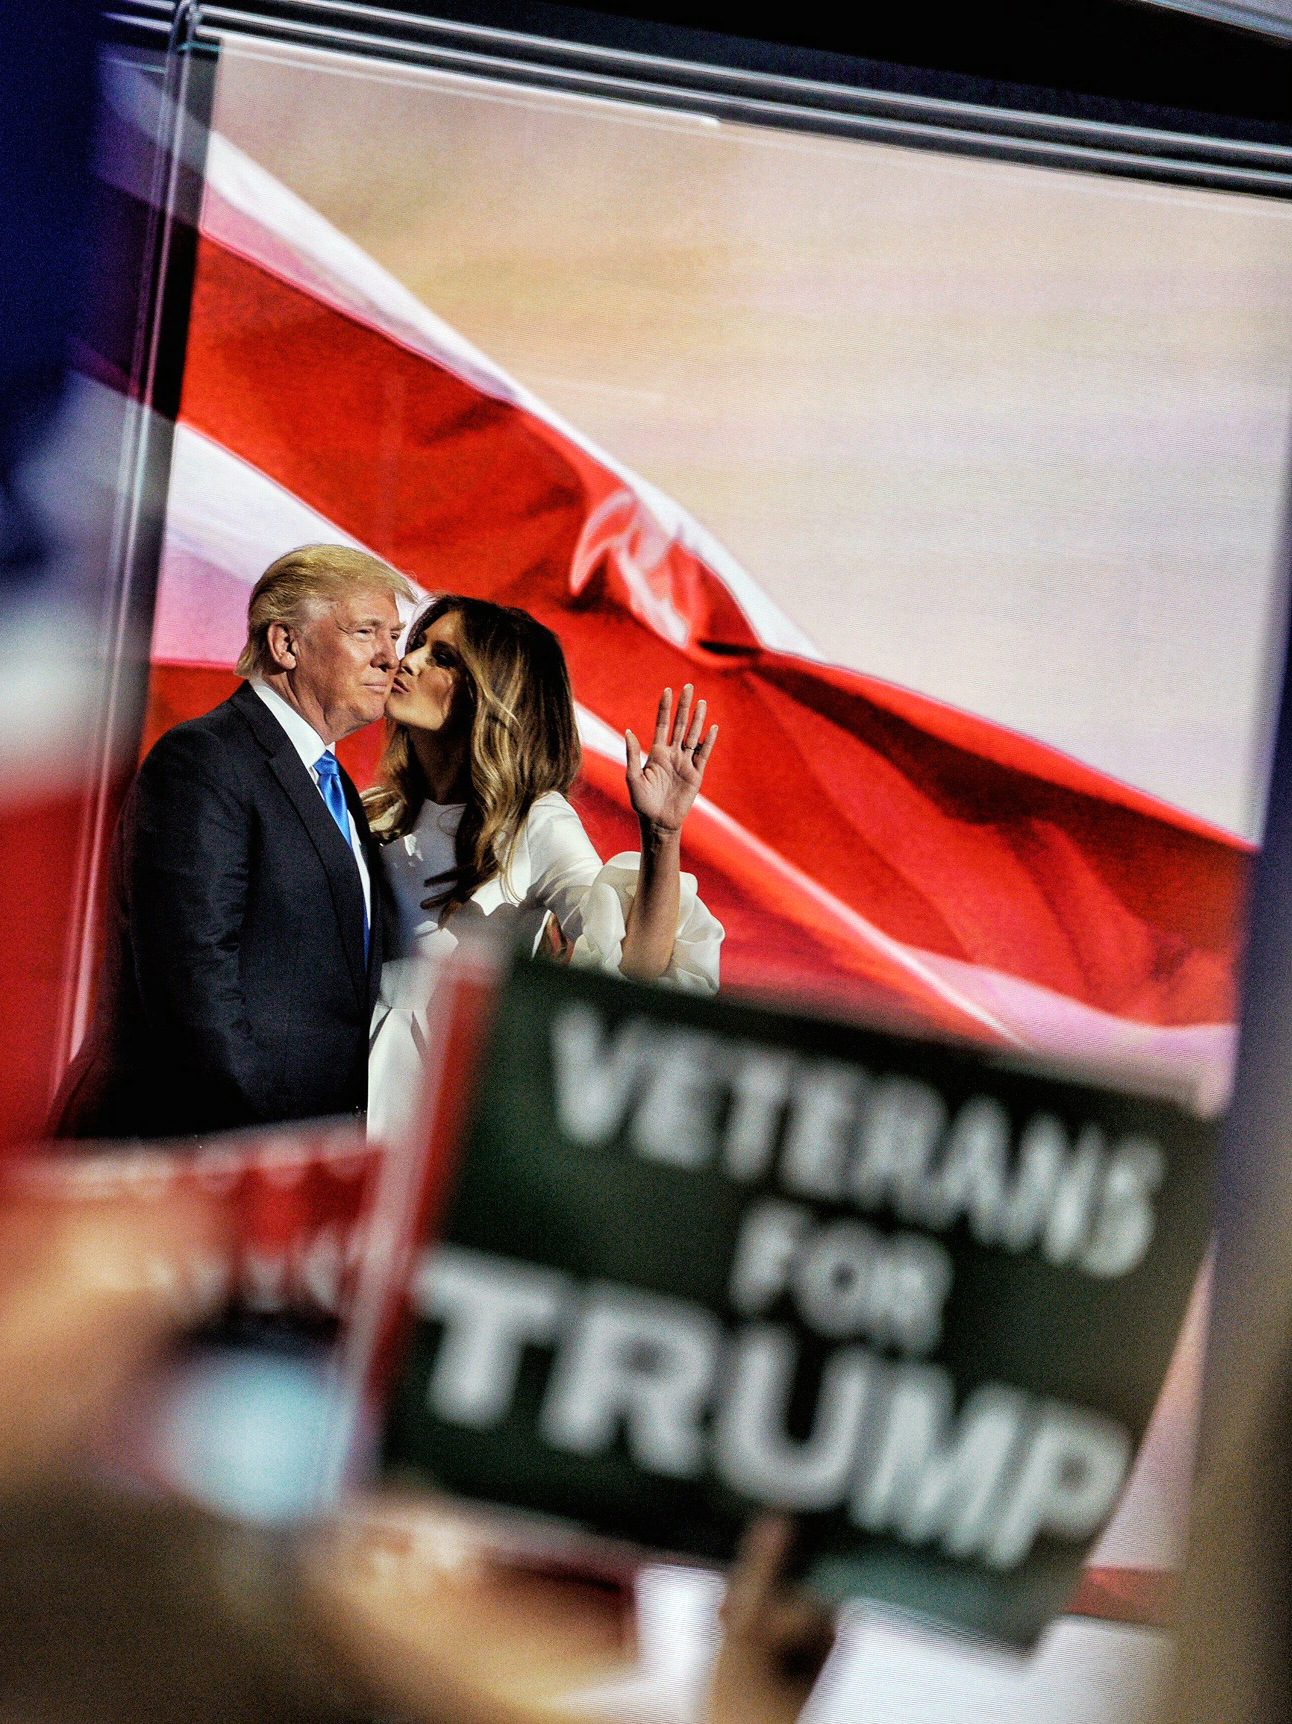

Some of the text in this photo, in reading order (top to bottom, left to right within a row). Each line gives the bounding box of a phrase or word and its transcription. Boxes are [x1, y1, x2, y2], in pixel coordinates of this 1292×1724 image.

[551, 1002, 1166, 1279] VETERANS
[731, 1201, 951, 1355] FOR
[416, 1245, 1133, 1570] TRUMP
